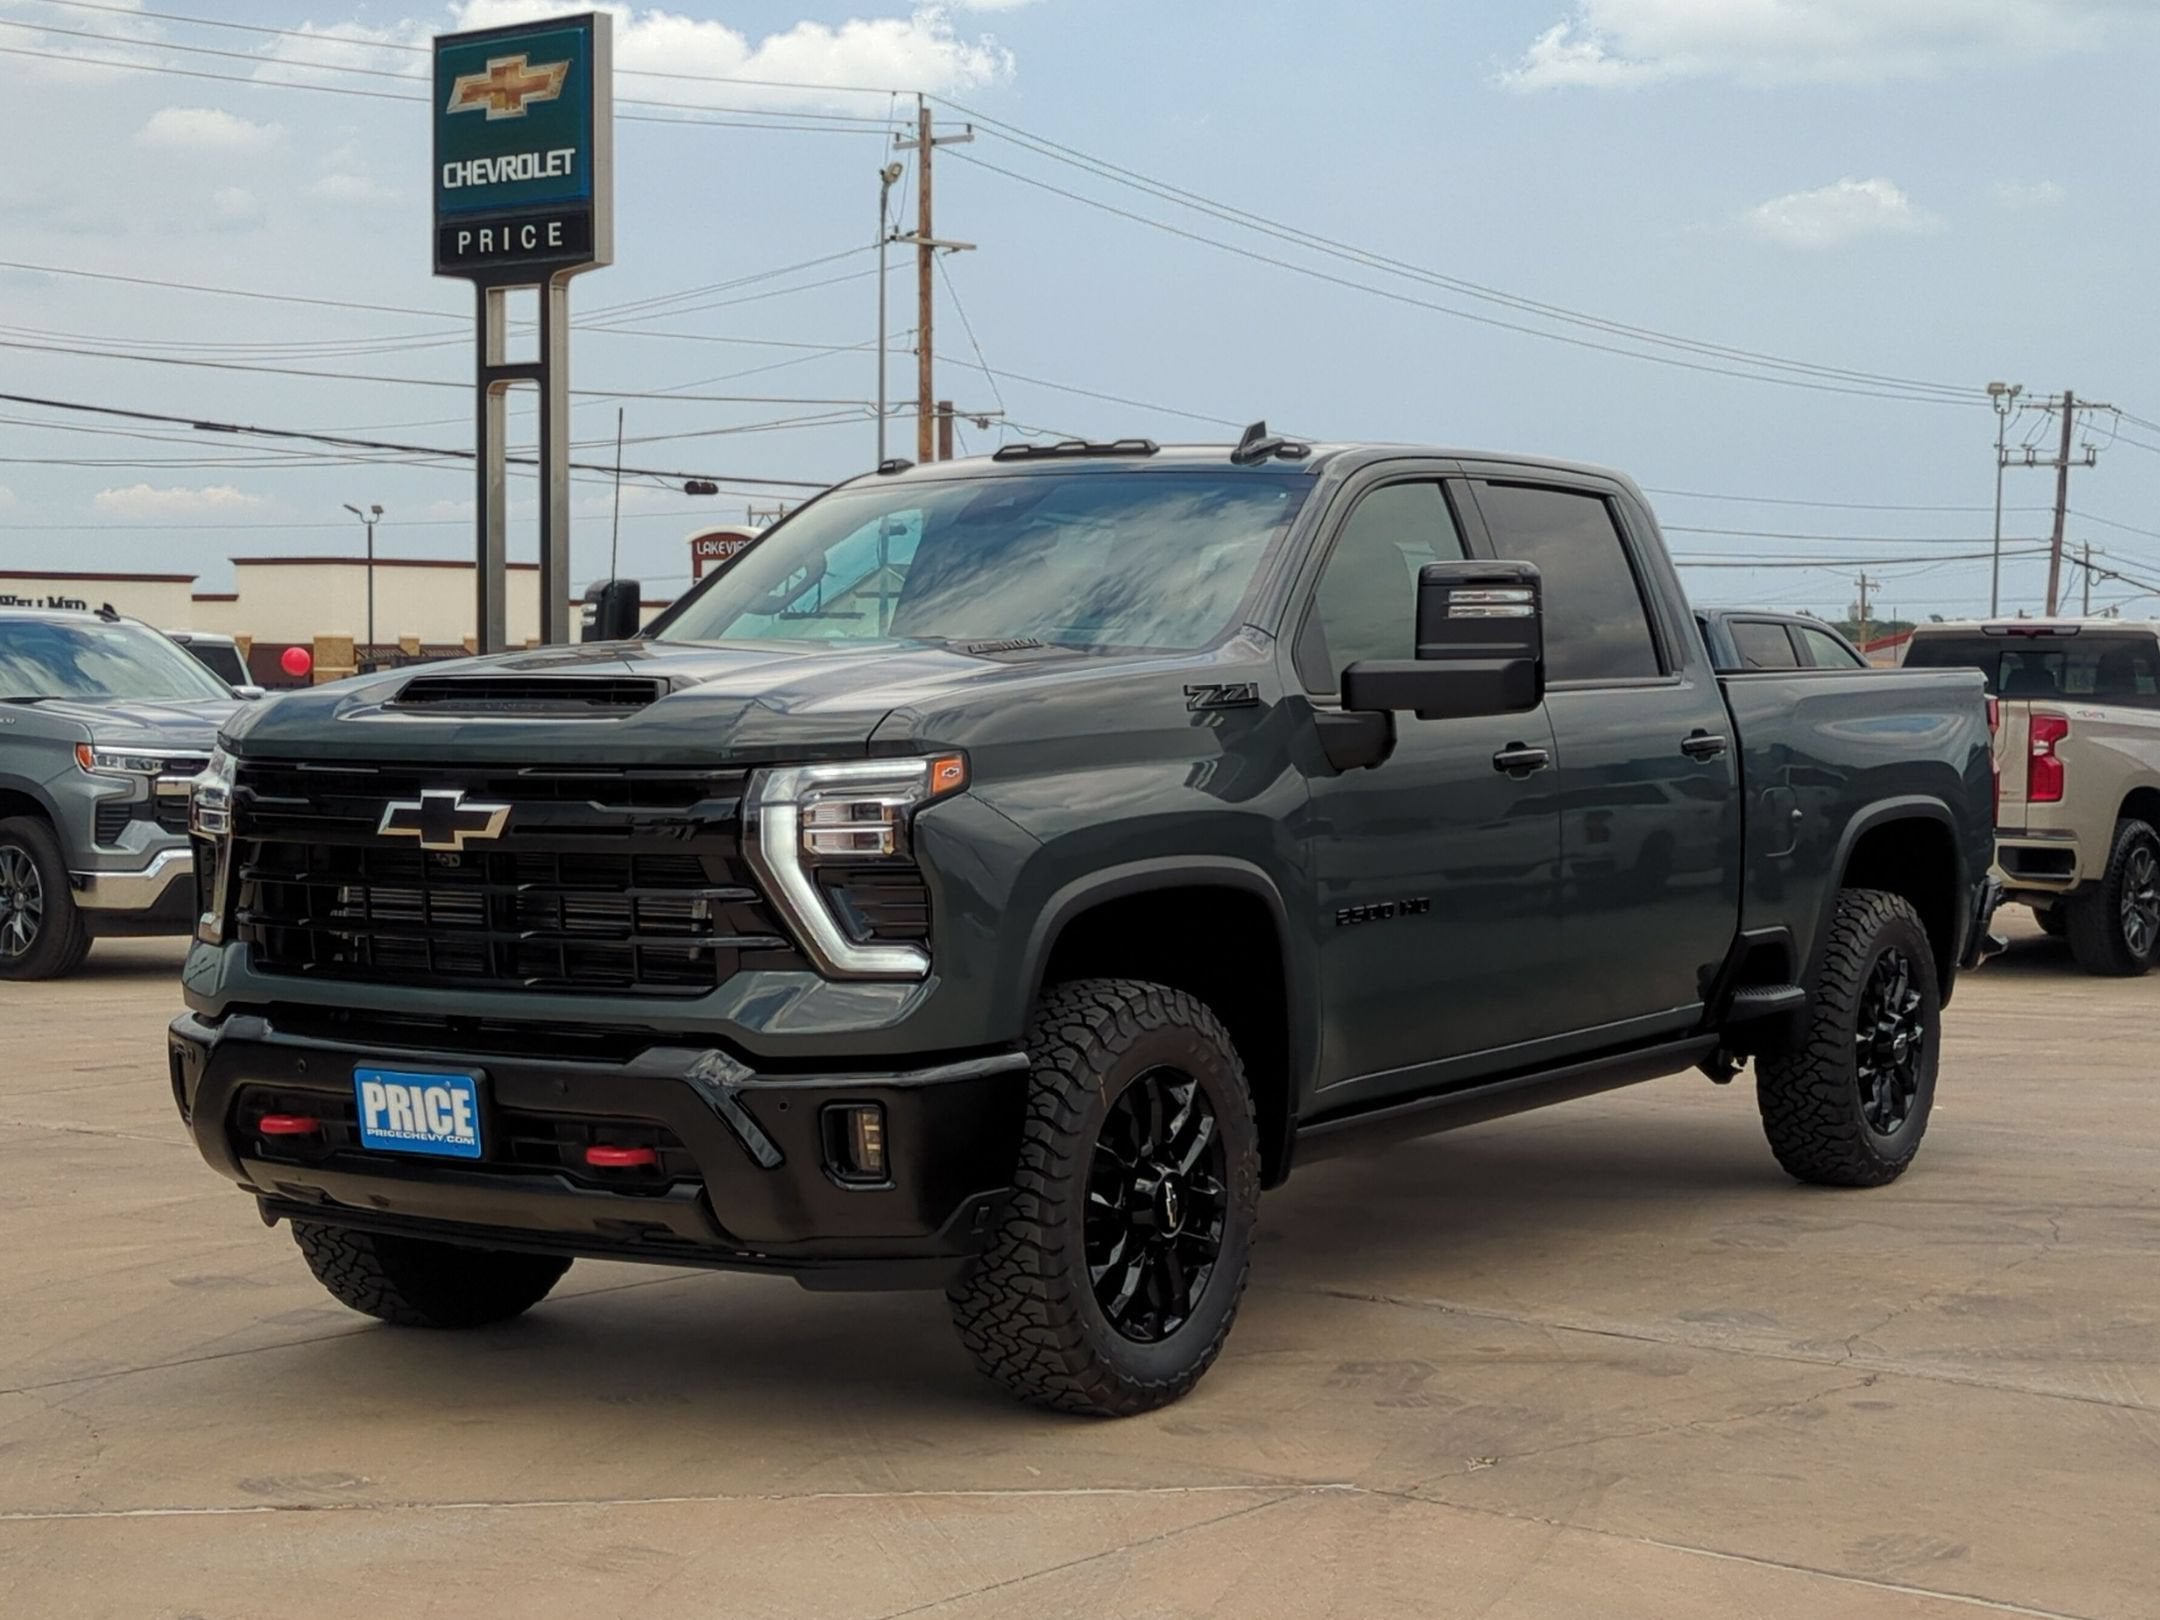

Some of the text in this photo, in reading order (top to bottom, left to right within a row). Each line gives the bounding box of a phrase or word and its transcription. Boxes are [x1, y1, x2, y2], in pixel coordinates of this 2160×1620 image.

[442, 148, 576, 189] CHEVROLET
[458, 222, 563, 254] PRICE
[1183, 682, 1259, 712] Z71
[361, 1081, 475, 1138] PRICE
[367, 1125, 476, 1146] PRICECHEVY.COM
